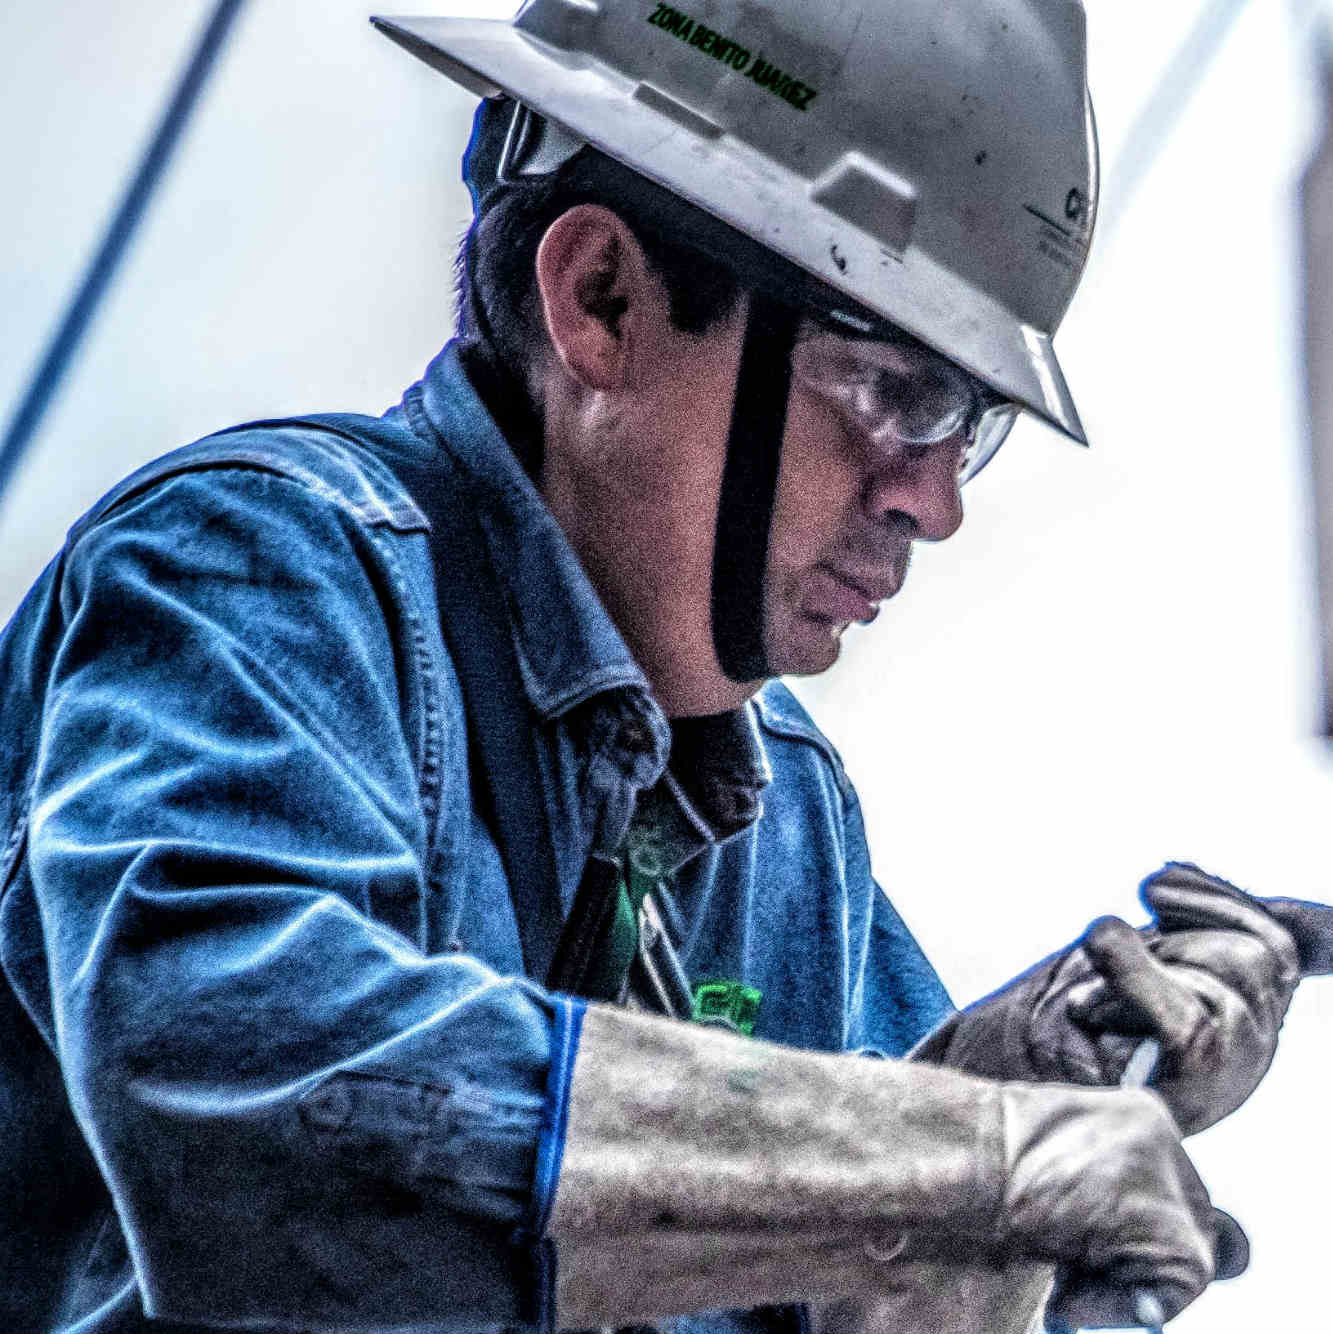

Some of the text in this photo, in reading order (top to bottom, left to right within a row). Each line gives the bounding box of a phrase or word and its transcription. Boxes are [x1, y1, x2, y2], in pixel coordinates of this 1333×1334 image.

[647, 3, 818, 112] ZONA BENITO JUAREZ
